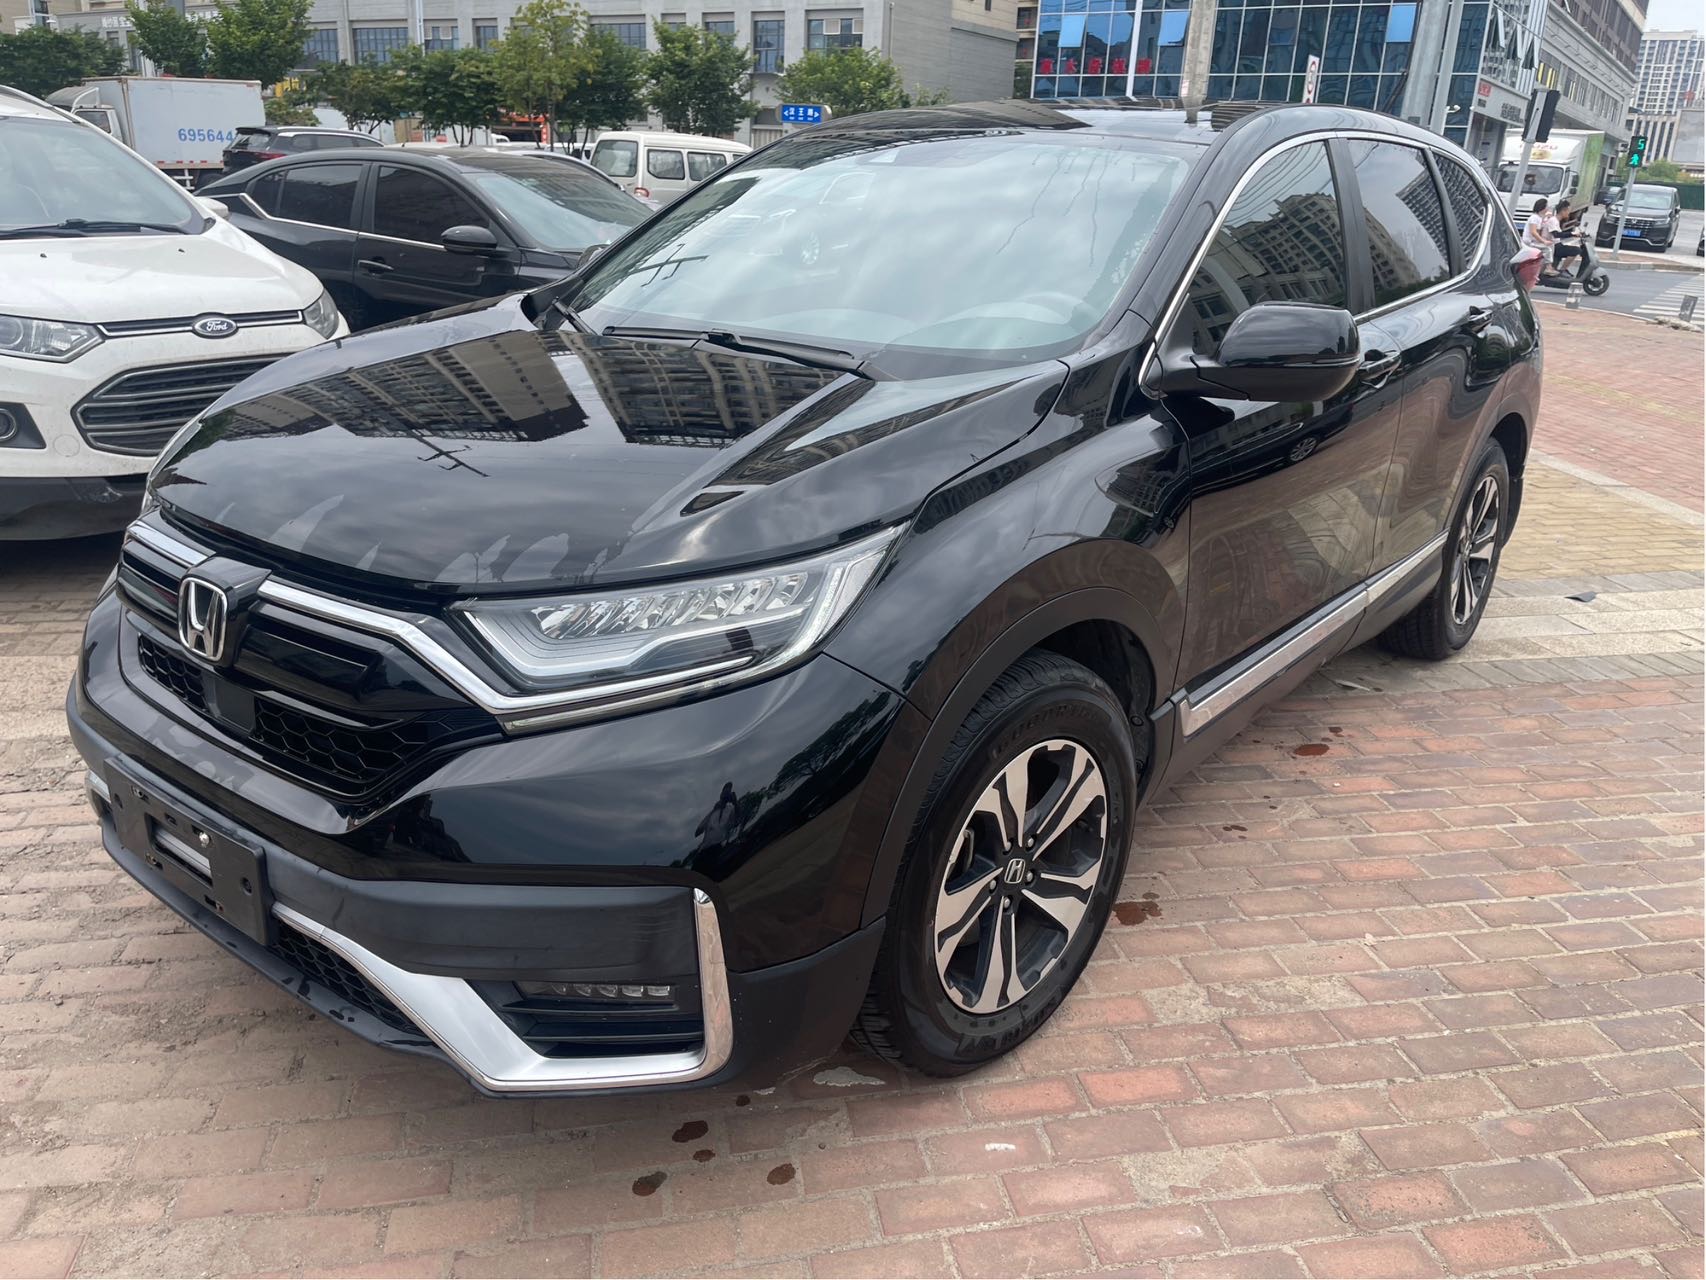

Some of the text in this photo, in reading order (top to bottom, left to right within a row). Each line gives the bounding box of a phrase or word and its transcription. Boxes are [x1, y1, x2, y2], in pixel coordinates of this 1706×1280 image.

[178, 128, 233, 142] 695644
[1638, 139, 1645, 150] 5
[206, 320, 229, 332] Ford
